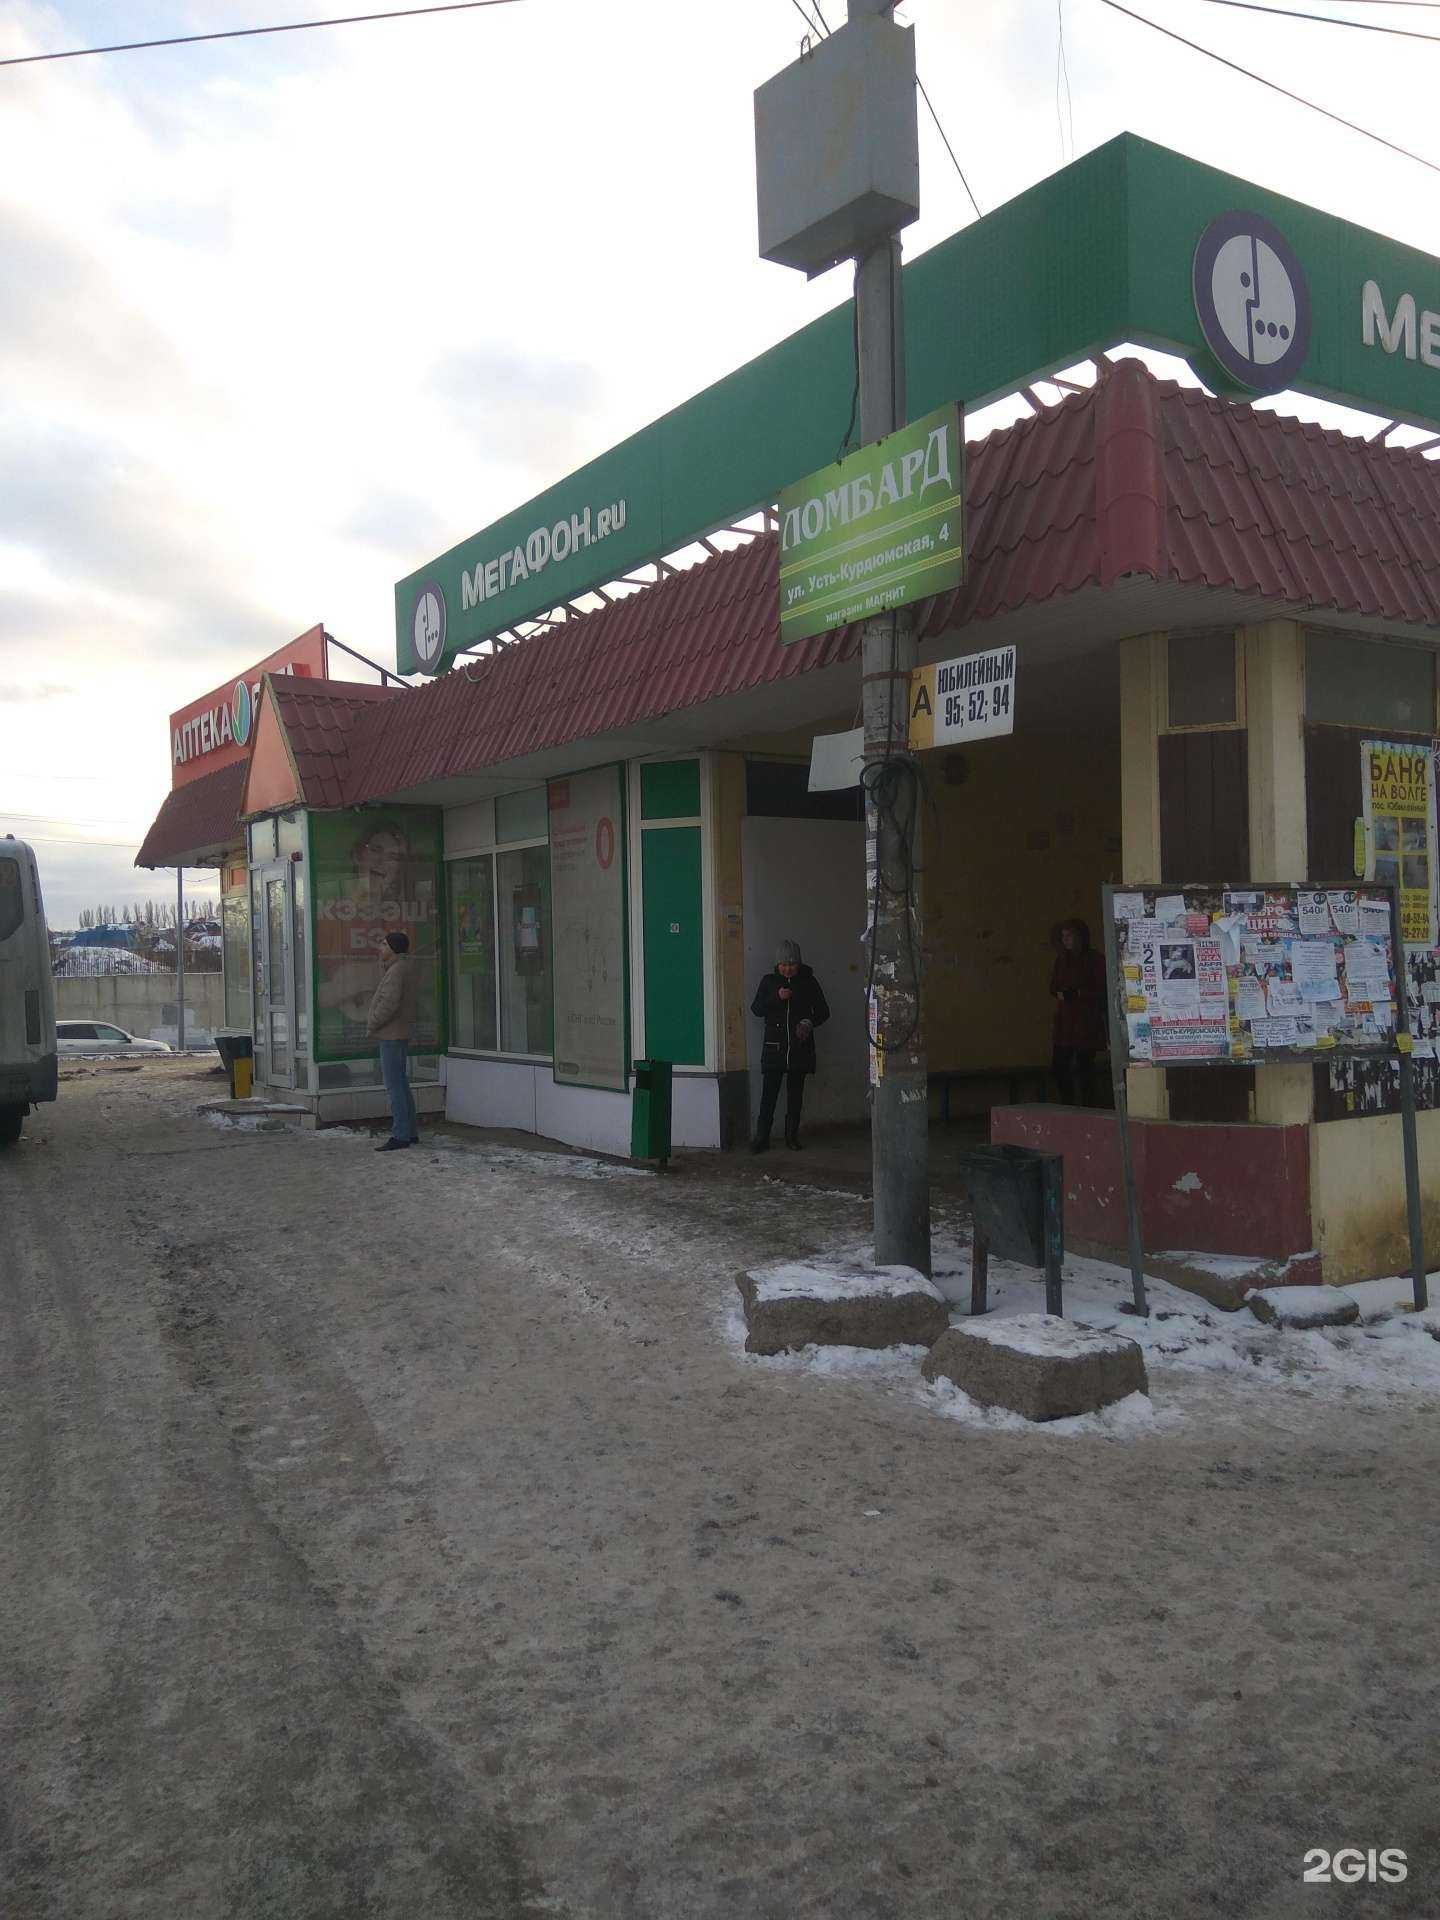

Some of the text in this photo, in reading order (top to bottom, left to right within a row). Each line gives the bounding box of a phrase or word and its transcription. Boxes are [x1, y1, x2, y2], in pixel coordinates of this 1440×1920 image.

[783, 424, 952, 550] ЛОМБАРД
[787, 585, 805, 605] ул.
[938, 523, 950, 542] 4
[826, 585, 907, 623] магазин МАГНИТ
[938, 648, 1014, 695] ЮБИЛЕЙНЫЙ
[945, 684, 1010, 728] 95; 52; 94
[174, 702, 233, 765] АПТЕКА
[1370, 753, 1426, 785] БАНЯ
[1371, 783, 1427, 802] НА ВОЛГЕ
